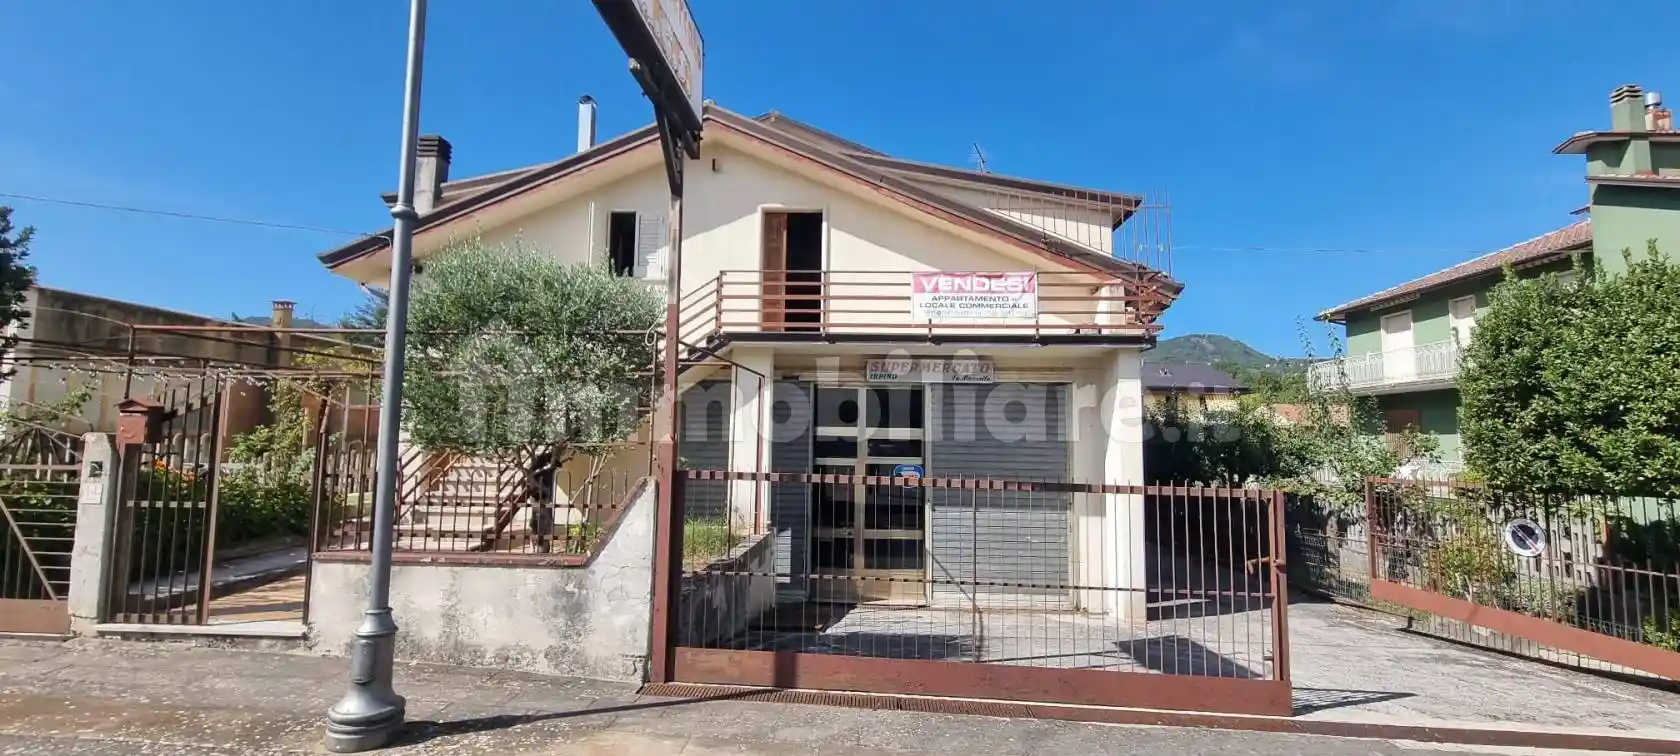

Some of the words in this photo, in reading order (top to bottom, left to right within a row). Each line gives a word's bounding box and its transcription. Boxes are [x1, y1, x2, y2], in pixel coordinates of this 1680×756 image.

[920, 275, 1030, 293] VENDESI
[871, 360, 990, 374] SUPERMERCATO
[870, 372, 898, 380] IRPINO
